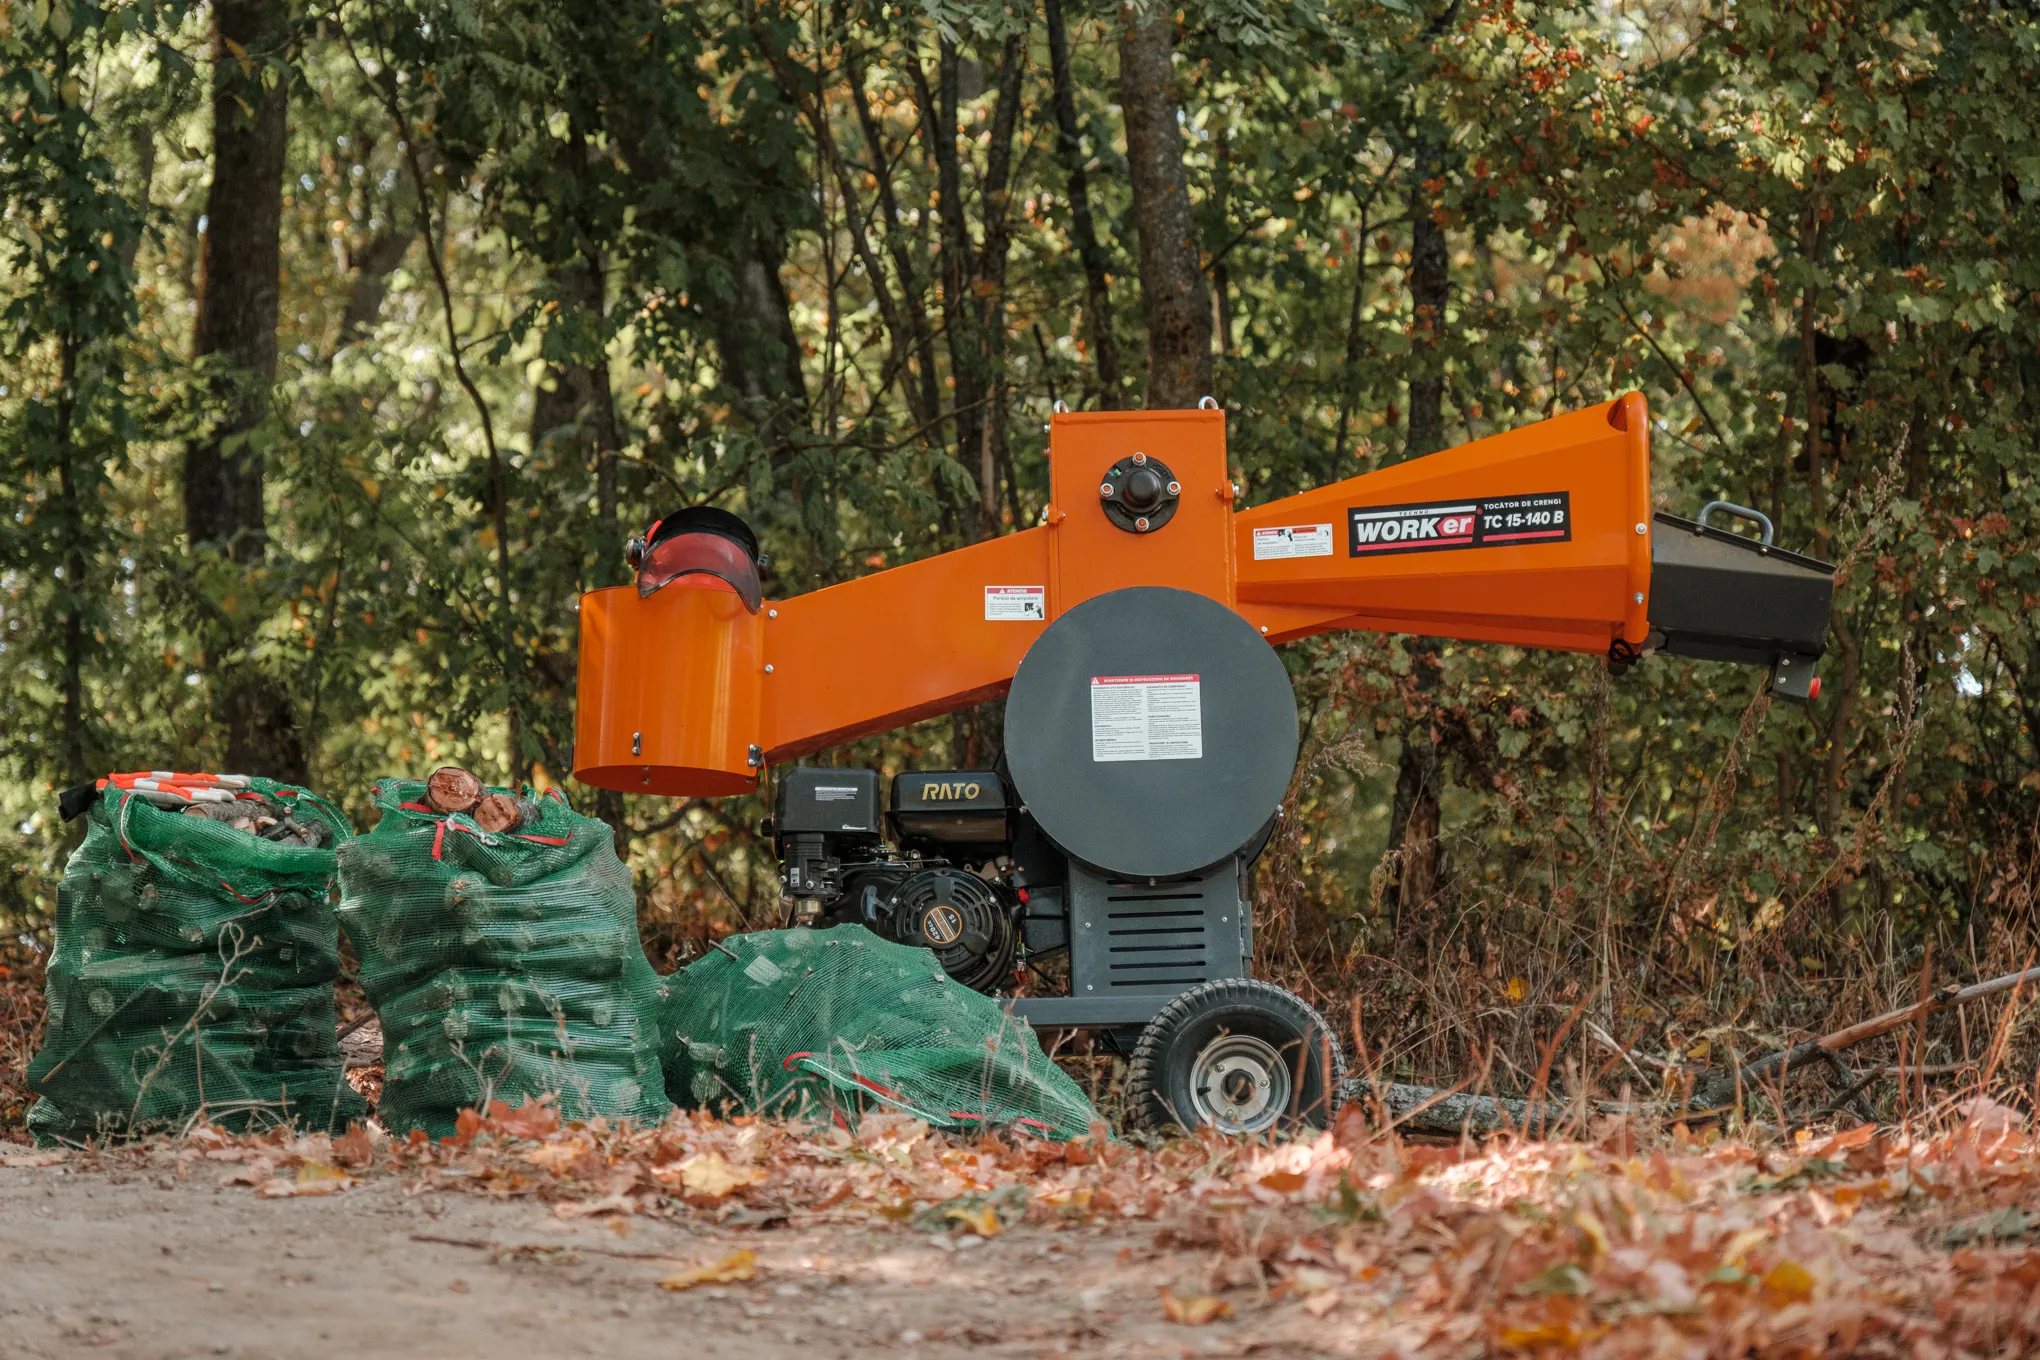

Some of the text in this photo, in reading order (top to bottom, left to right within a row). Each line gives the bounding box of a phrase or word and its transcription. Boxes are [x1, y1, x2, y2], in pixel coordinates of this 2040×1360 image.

[1483, 510, 1565, 529] TC 15-140 B
[922, 783, 980, 800] RATO
[948, 914, 957, 924] 15
[927, 920, 940, 940] 420cc
